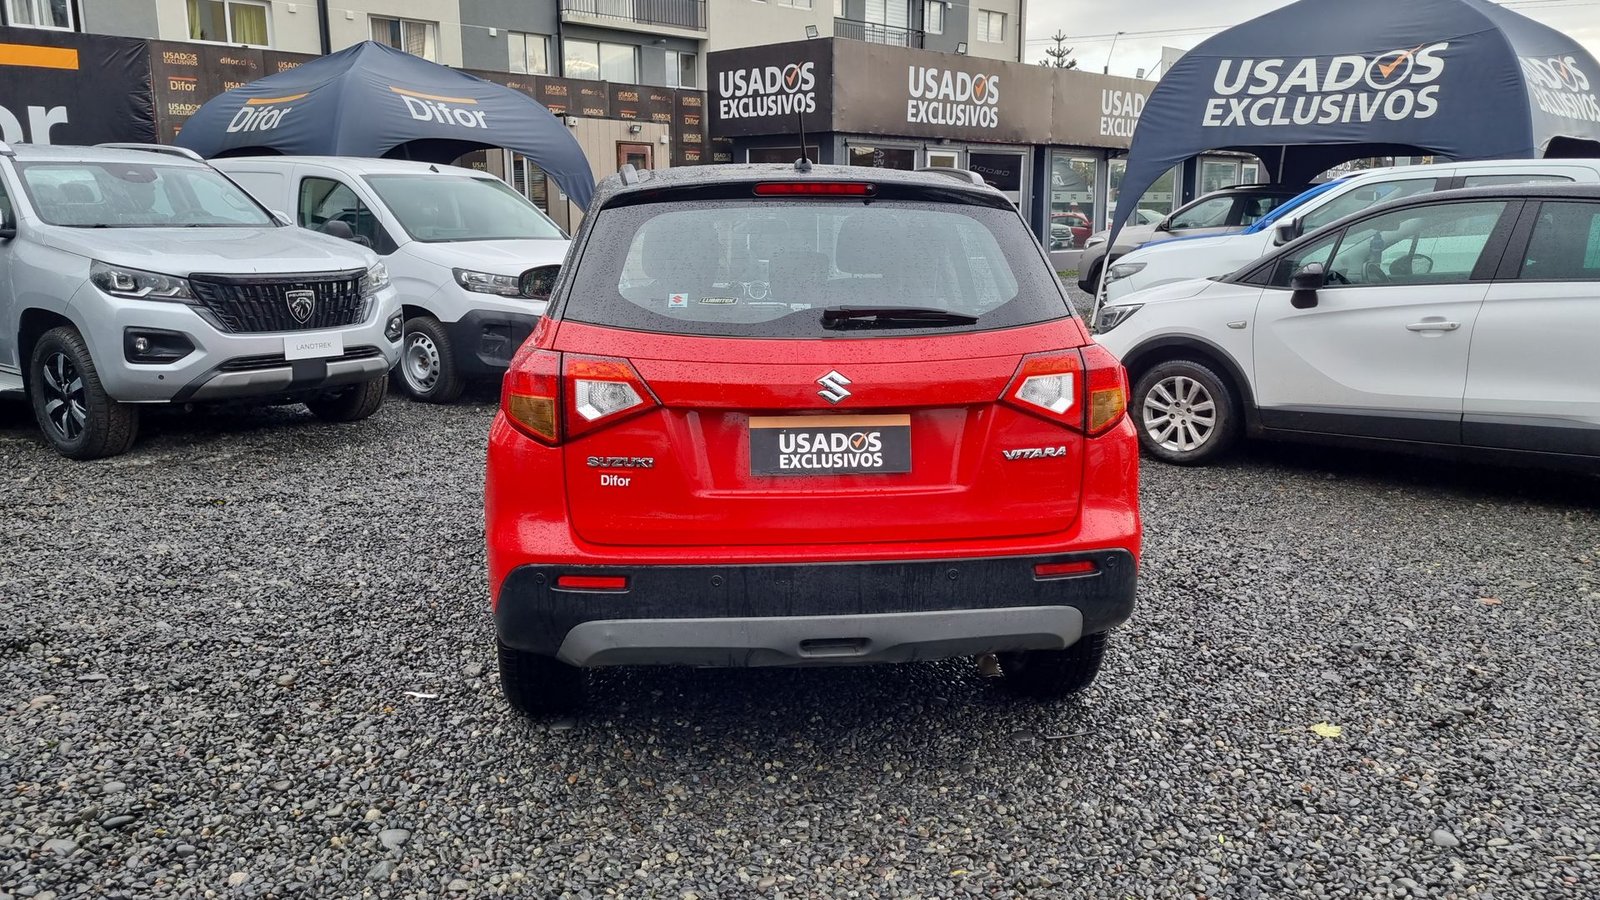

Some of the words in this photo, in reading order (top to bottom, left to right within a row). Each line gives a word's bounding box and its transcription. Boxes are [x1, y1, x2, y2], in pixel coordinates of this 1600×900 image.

[163, 51, 198, 61] USADOS
[719, 61, 816, 98] USADOS
[1213, 42, 1449, 95] USADOS
[170, 80, 197, 92] Difor
[908, 65, 999, 105] USADOS
[400, 94, 488, 129] Difor
[719, 92, 816, 119] EXCLUSIVOS
[907, 99, 999, 128] EXCLUSIVOS
[1101, 89, 1150, 118] USAD
[1202, 84, 1440, 127] EXCLUSIVOS
[226, 105, 293, 133] Difor
[1100, 116, 1138, 137] EXCLU
[296, 342, 332, 350] LANDTREK
[778, 432, 882, 453] USADOS
[1002, 446, 1067, 460] VITARA
[586, 456, 654, 467] SUZUKI
[779, 453, 883, 469] EXCLUSIVOS
[600, 474, 631, 486] Difor
